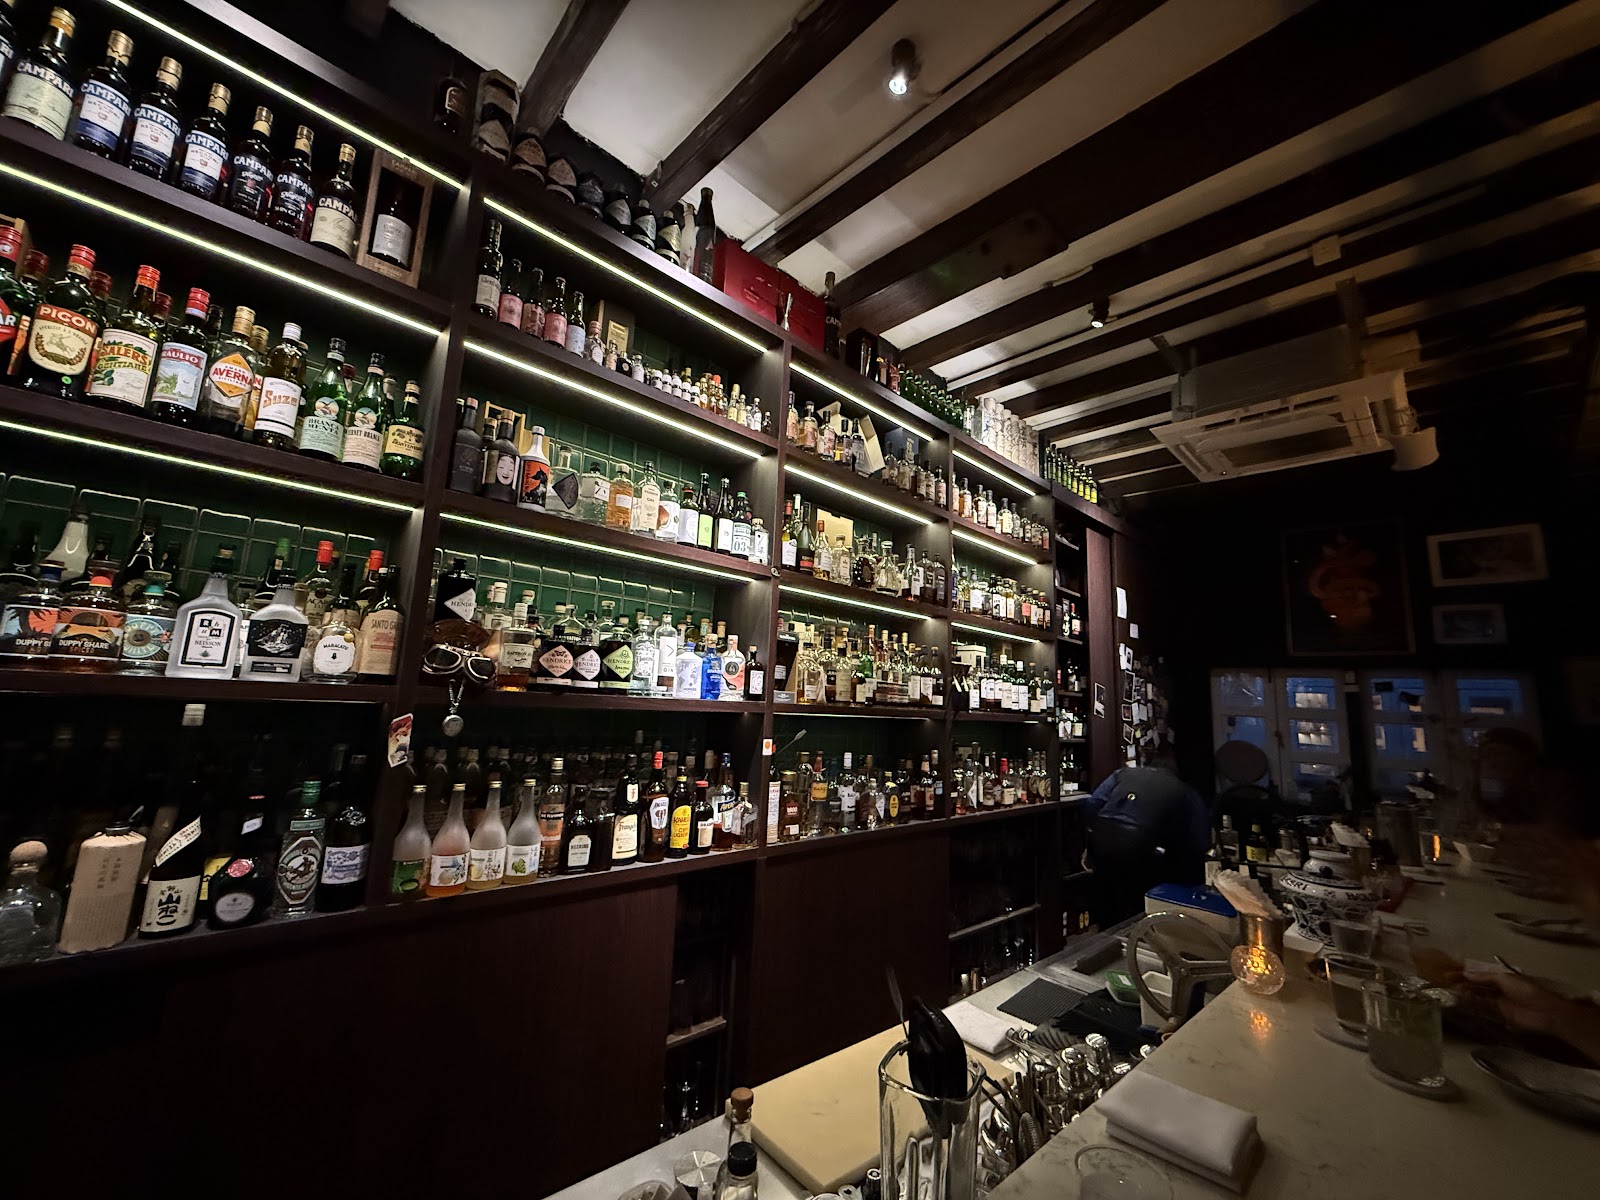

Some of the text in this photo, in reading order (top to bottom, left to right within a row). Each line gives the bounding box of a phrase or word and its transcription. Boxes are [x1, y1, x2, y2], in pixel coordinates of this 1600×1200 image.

[17, 61, 74, 98] CAMPARI
[81, 83, 131, 116] CAMPARI
[134, 108, 181, 136] CAMPARI
[185, 133, 229, 161] CAMPARI
[277, 174, 315, 198] CAMPAR
[318, 197, 358, 222] CAMPA
[39, 306, 97, 334] PICON
[100, 345, 148, 365] SALERS
[212, 367, 253, 387] AVERNA
[371, 619, 389, 629] SANTO
[84, 641, 109, 649] SHARE
